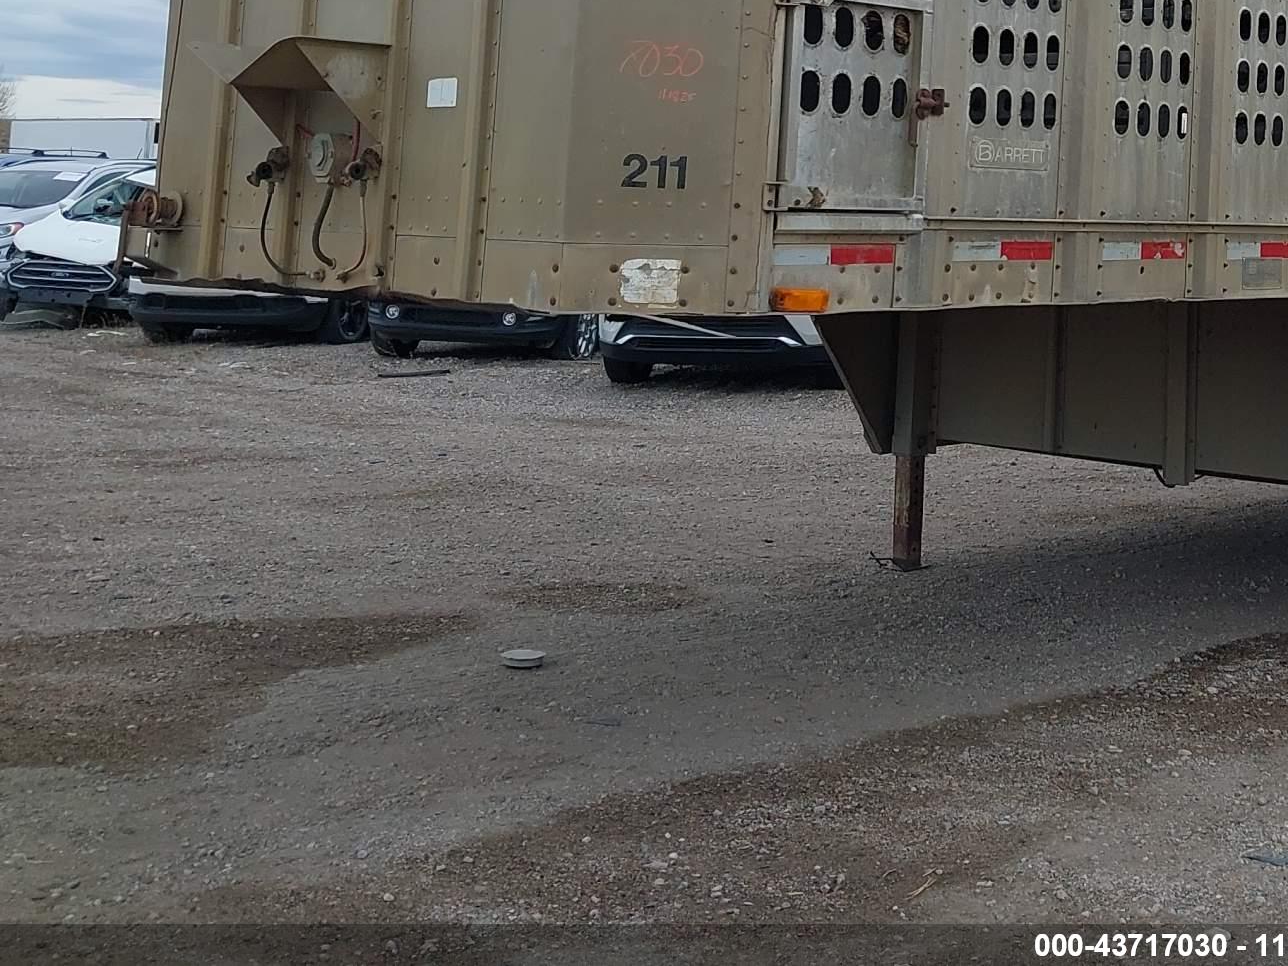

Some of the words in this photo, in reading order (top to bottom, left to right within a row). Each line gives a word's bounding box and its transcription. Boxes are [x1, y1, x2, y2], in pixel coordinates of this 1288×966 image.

[620, 40, 704, 77] 7030
[976, 140, 1046, 163] BARRETT
[621, 153, 688, 189] 211
